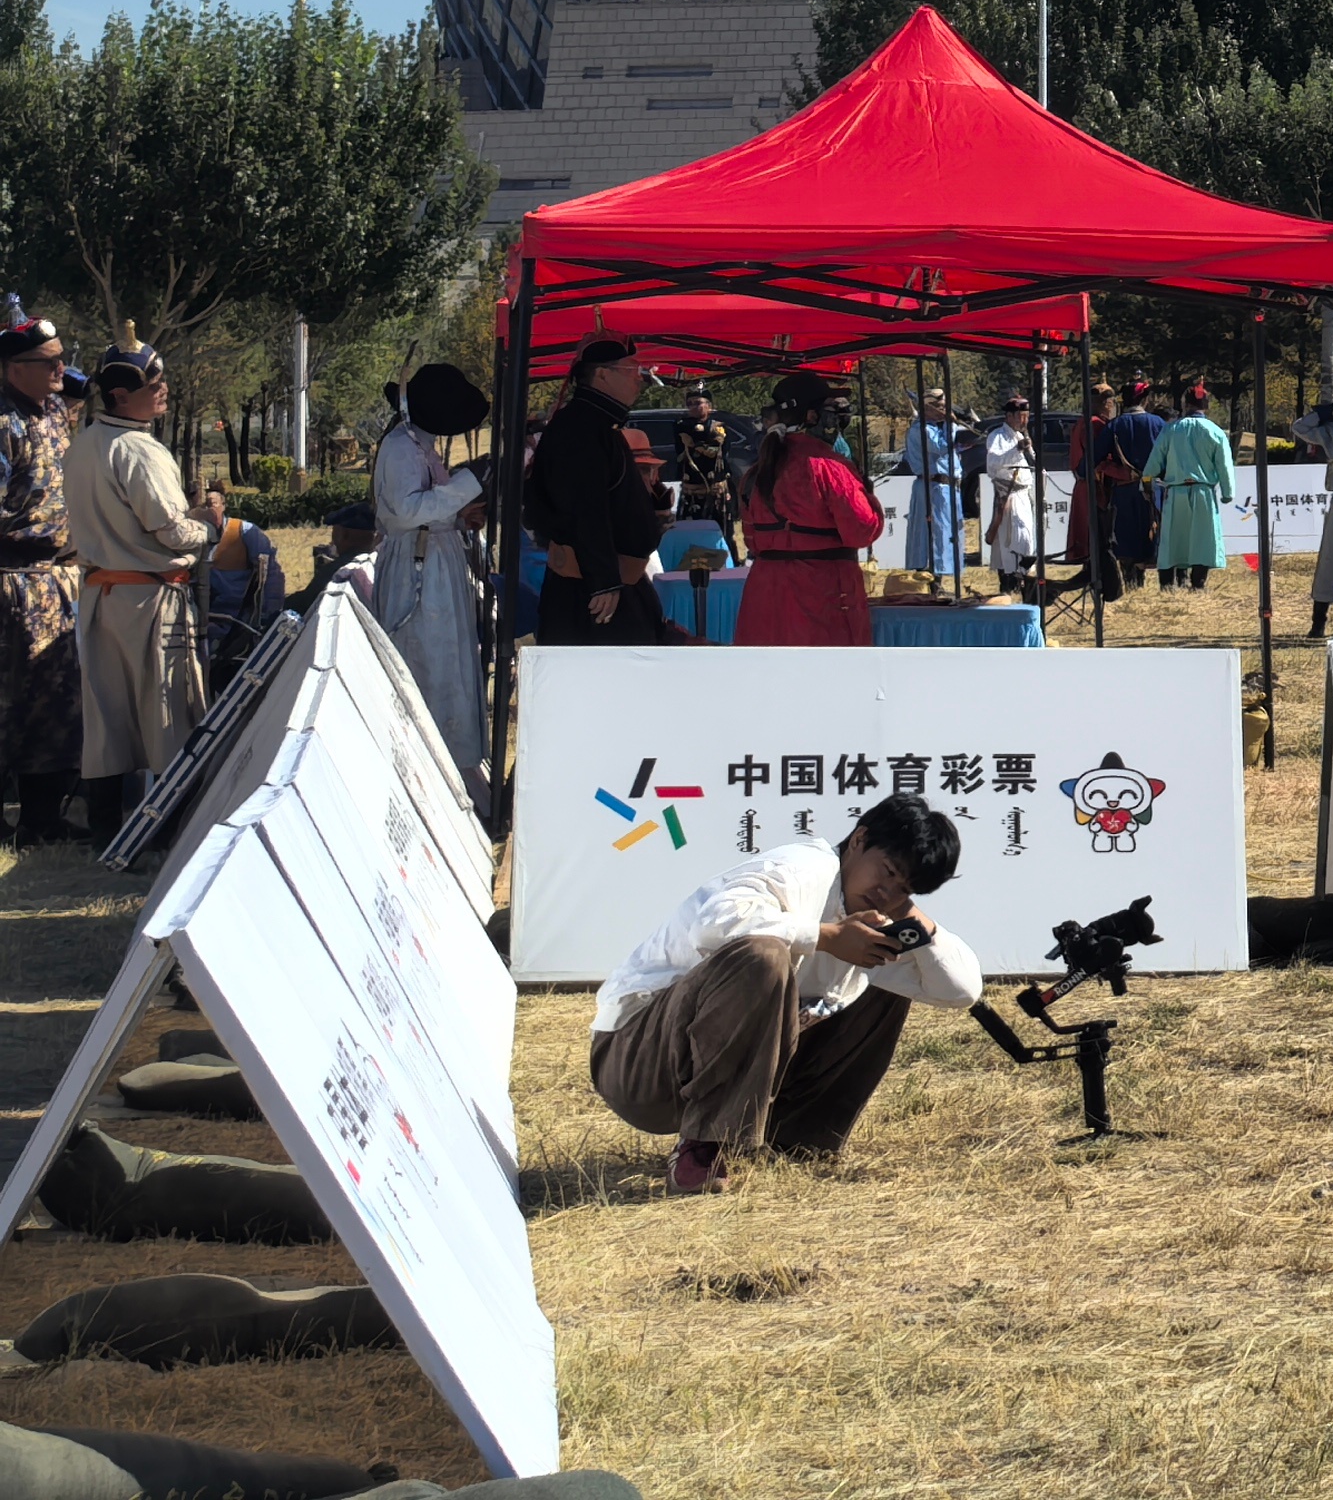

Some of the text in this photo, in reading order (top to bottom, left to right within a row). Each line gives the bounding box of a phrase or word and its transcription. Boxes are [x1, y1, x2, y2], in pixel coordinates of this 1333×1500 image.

[728, 753, 1037, 796] 中国体育彩票
[1056, 968, 1088, 997] RONIN
